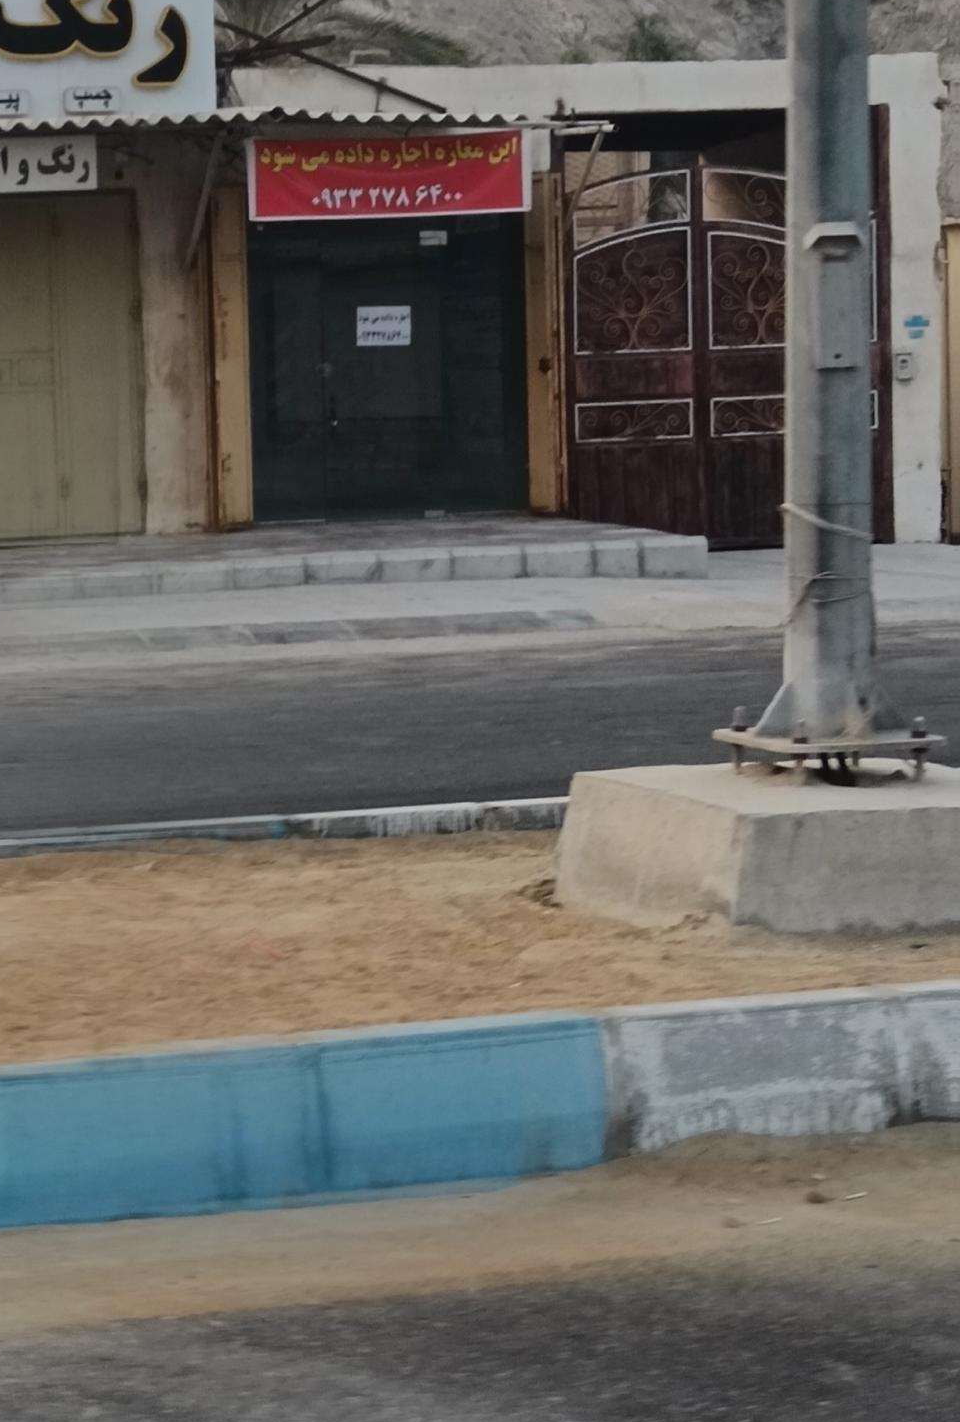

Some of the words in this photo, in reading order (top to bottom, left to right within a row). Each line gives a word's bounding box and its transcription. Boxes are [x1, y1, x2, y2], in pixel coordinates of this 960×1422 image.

[38, 143, 90, 183] رنگ
[302, 152, 330, 171] می
[335, 143, 374, 163] داده
[16, 157, 29, 186] و
